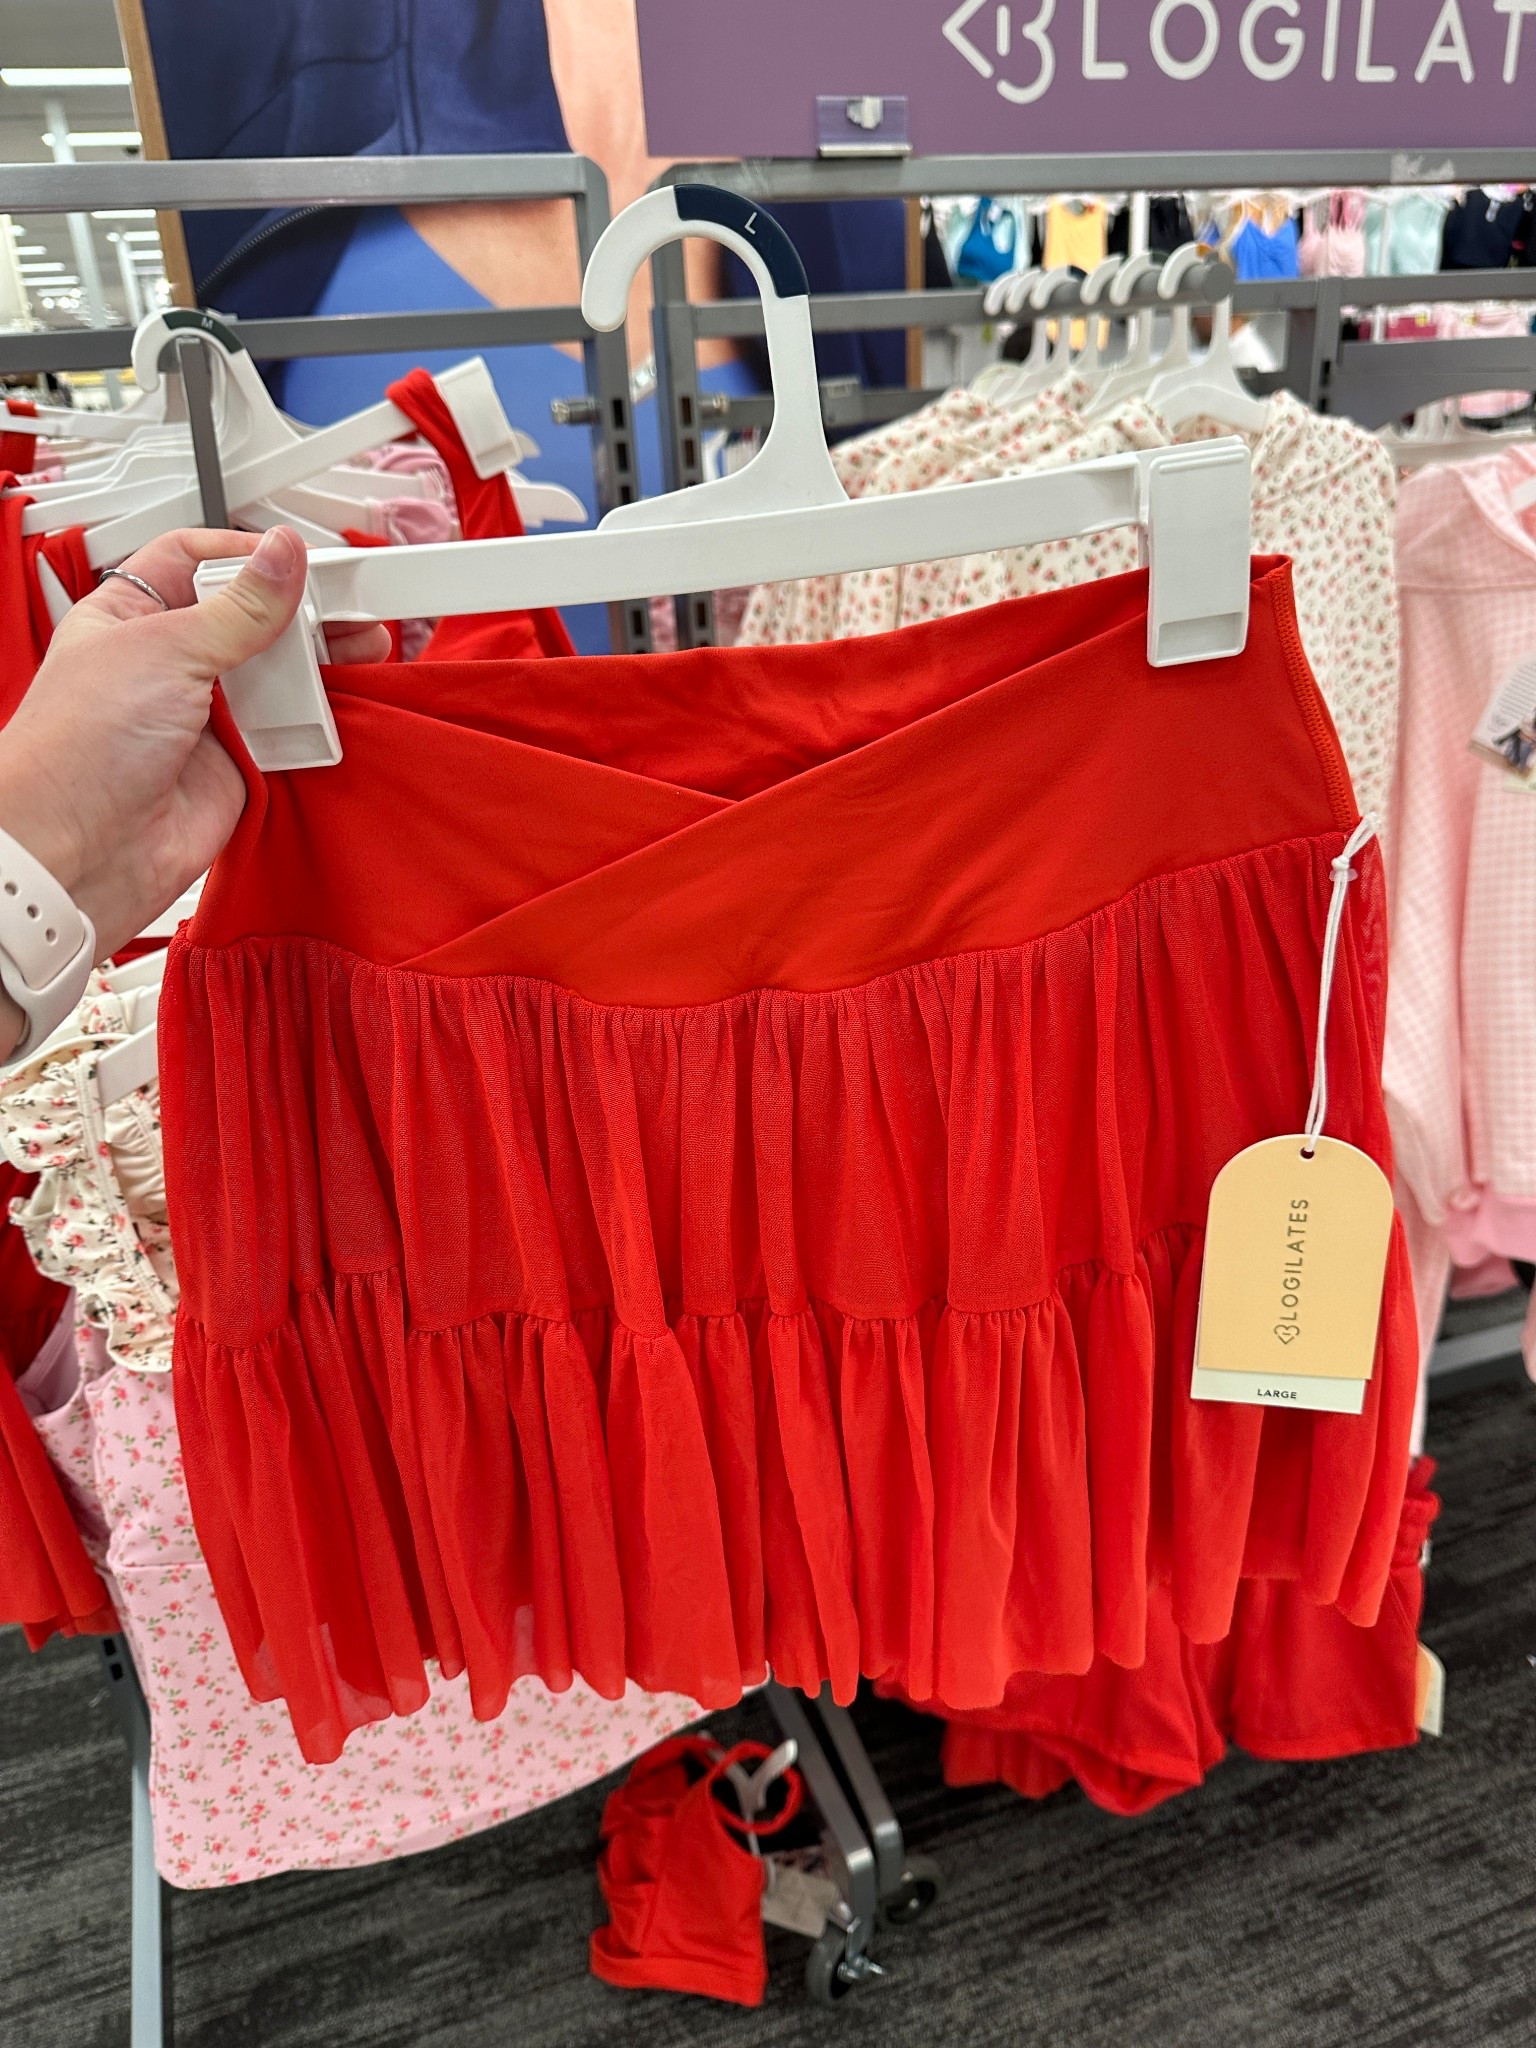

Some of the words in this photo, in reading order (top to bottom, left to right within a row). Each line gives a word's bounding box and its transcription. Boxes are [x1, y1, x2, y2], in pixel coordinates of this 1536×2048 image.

[744, 211, 758, 235] L
[201, 316, 214, 330] M
[1273, 1199, 1309, 1345] BLOGILATES
[1256, 1388, 1298, 1400] LARGE
